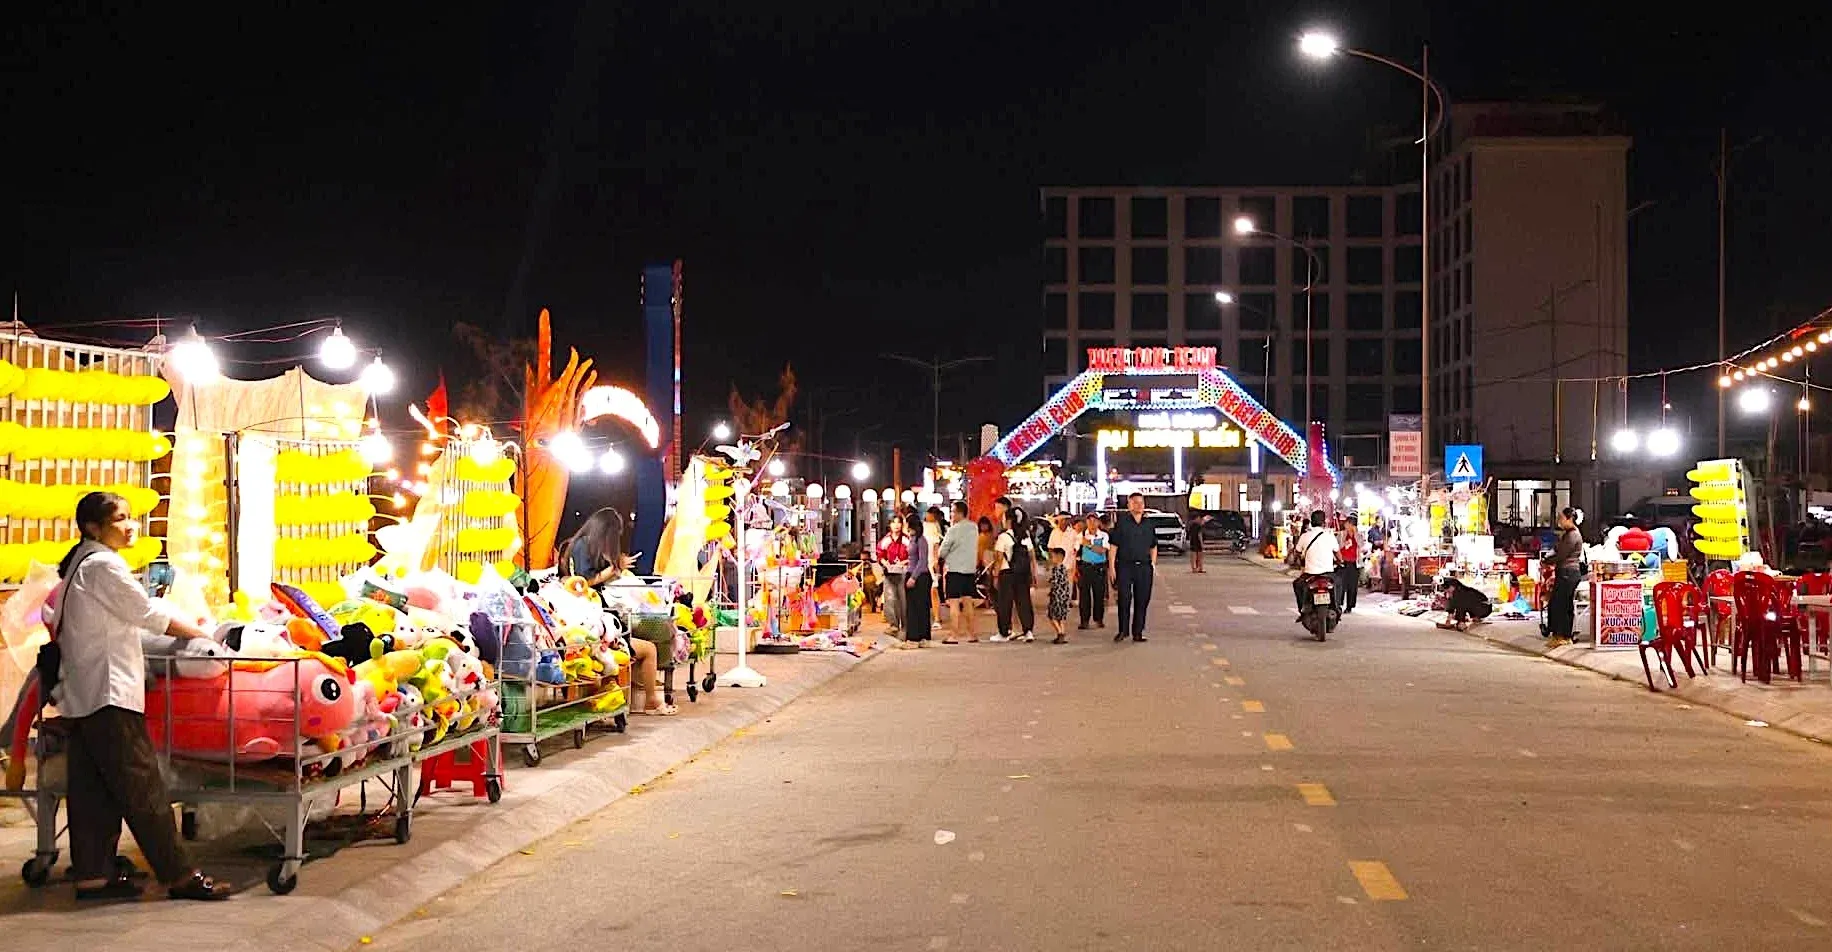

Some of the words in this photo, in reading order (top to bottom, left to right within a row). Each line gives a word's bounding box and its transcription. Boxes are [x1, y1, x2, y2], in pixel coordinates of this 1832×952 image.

[1173, 346, 1217, 371] BEACH
[1006, 416, 1052, 457] BEACH
[1048, 391, 1085, 425] CLUB
[1217, 389, 1263, 430] BEACH
[1261, 422, 1297, 456] CLUB
